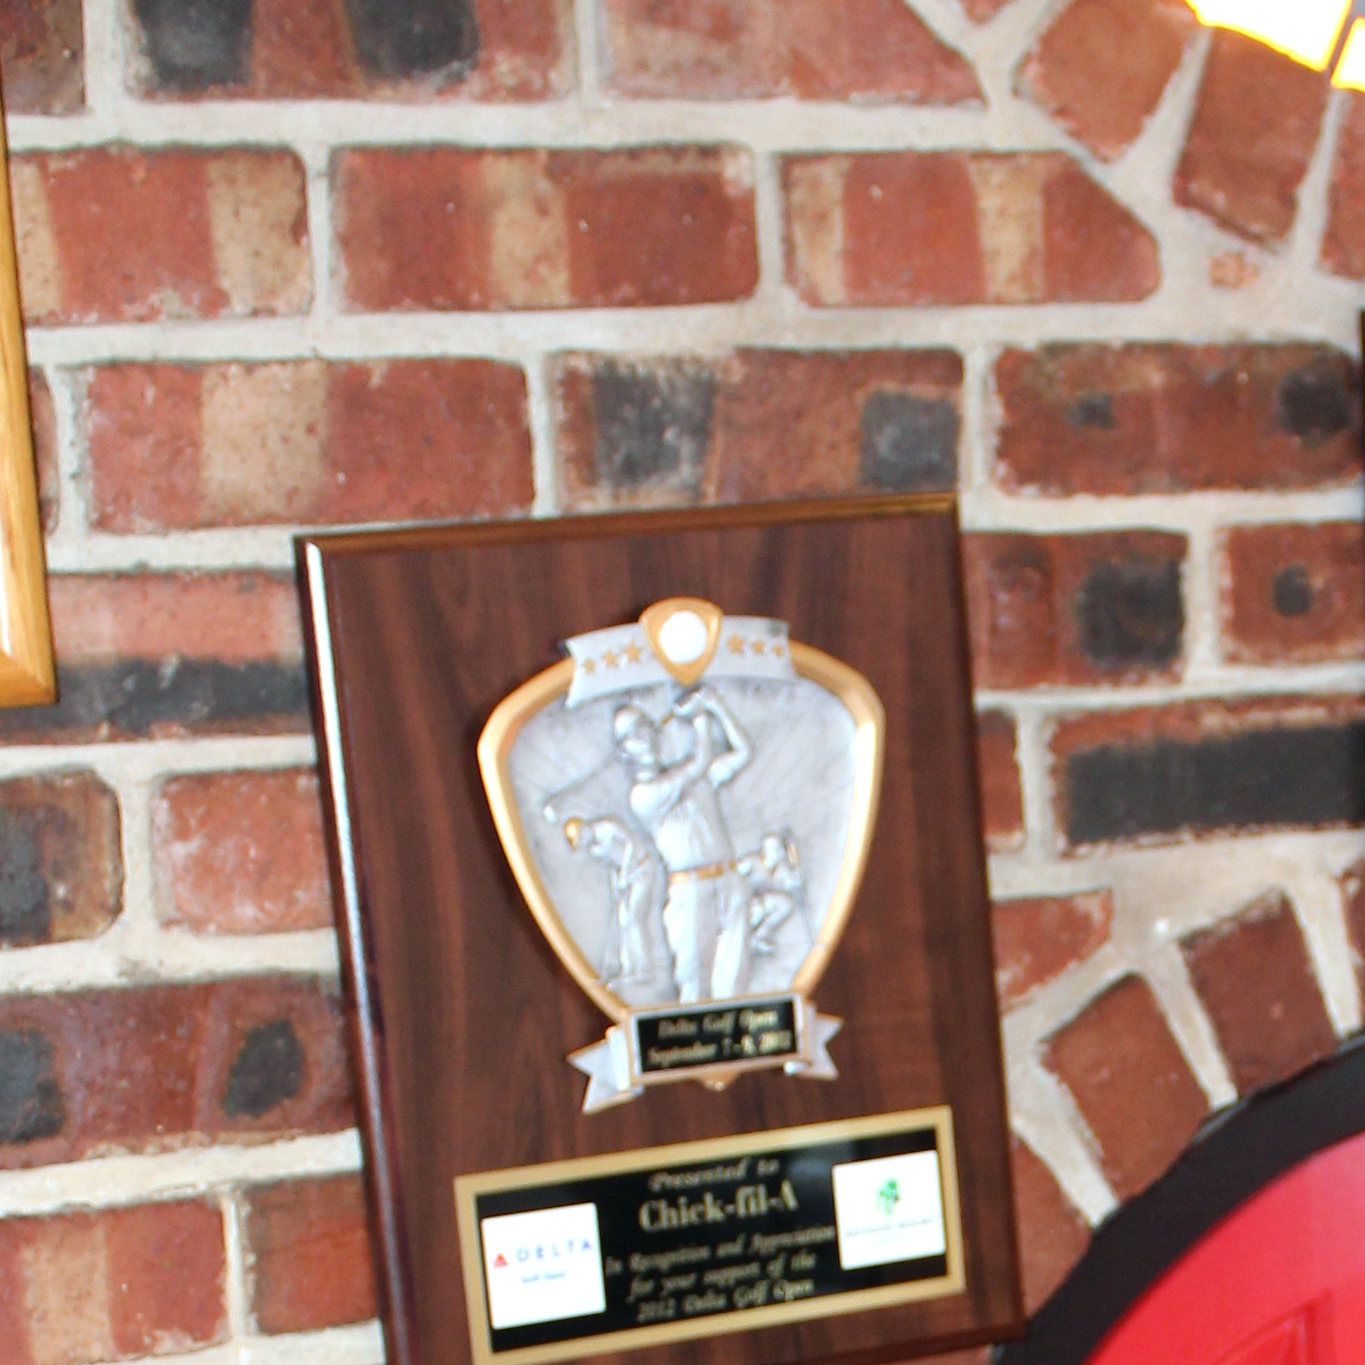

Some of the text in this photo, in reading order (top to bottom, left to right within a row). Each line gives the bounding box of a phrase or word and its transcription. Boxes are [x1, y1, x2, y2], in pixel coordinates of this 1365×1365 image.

[739, 1008, 779, 1034] Open
[648, 1158, 780, 1192] Presented to
[638, 1178, 800, 1233] Chick-fil-A
[516, 1238, 593, 1264] DELTA
[629, 1245, 711, 1273] Recognition
[716, 1233, 746, 1258] and
[626, 1249, 818, 1304] for your support of the
[733, 1279, 771, 1308] Golf
[773, 1278, 816, 1302] Open
